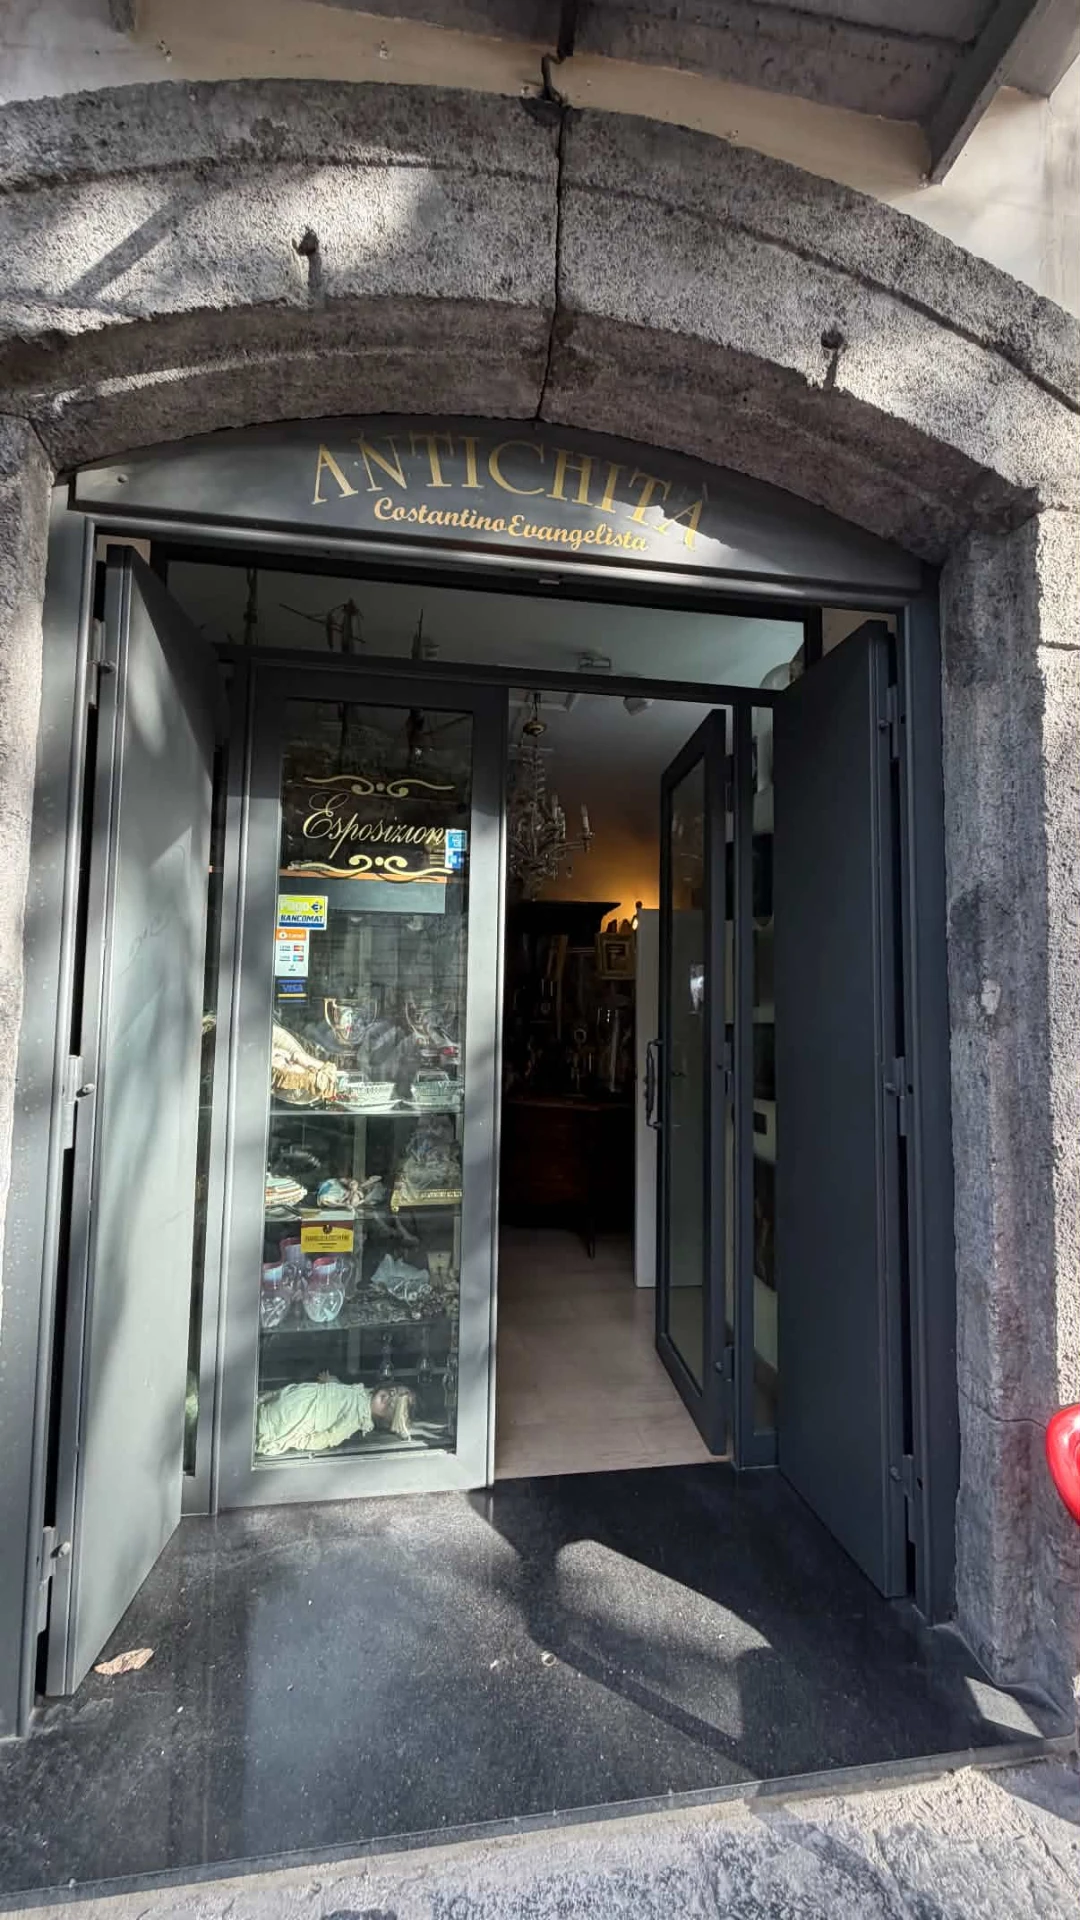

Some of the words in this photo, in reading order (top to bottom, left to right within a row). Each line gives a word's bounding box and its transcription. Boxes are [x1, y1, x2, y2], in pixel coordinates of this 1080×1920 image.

[373, 496, 507, 532] Costantino
[507, 514, 648, 552] Evangelista
[302, 792, 446, 860] Esposizion
[280, 914, 323, 923] BANCOMAT
[282, 984, 304, 993] VISA
